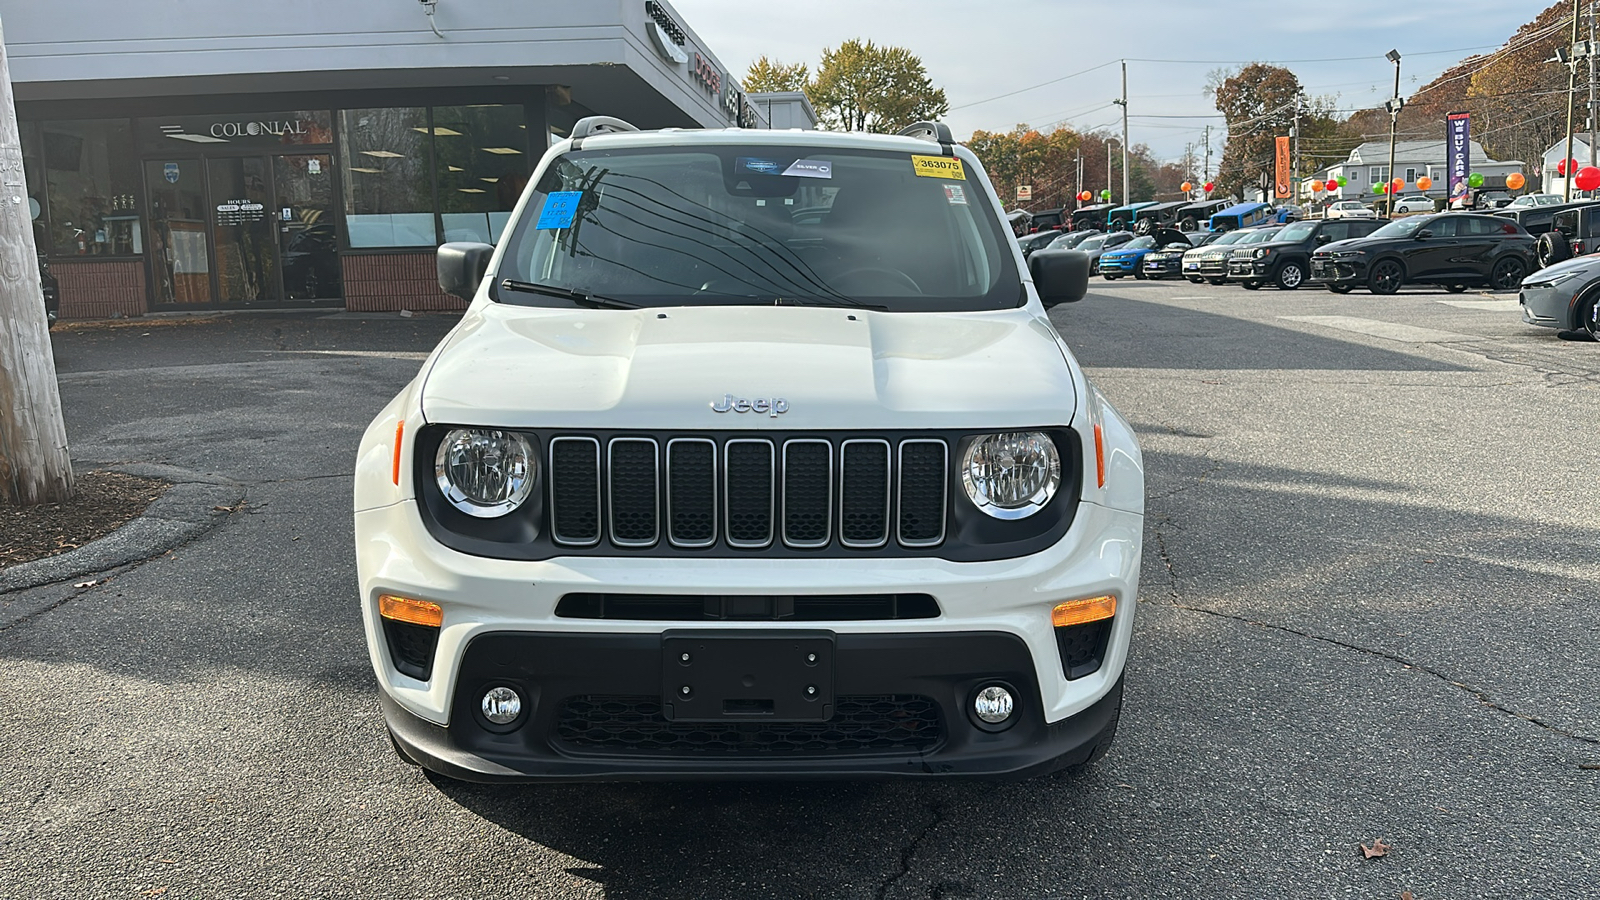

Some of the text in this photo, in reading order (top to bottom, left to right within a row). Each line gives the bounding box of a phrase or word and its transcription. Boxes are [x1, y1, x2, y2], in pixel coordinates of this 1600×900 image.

[692, 51, 720, 94] DODGE
[210, 120, 307, 138] COLONIAL
[1454, 120, 1465, 177] WE BUY CARS
[920, 160, 960, 170] 363075
[709, 393, 789, 418] Jeep
